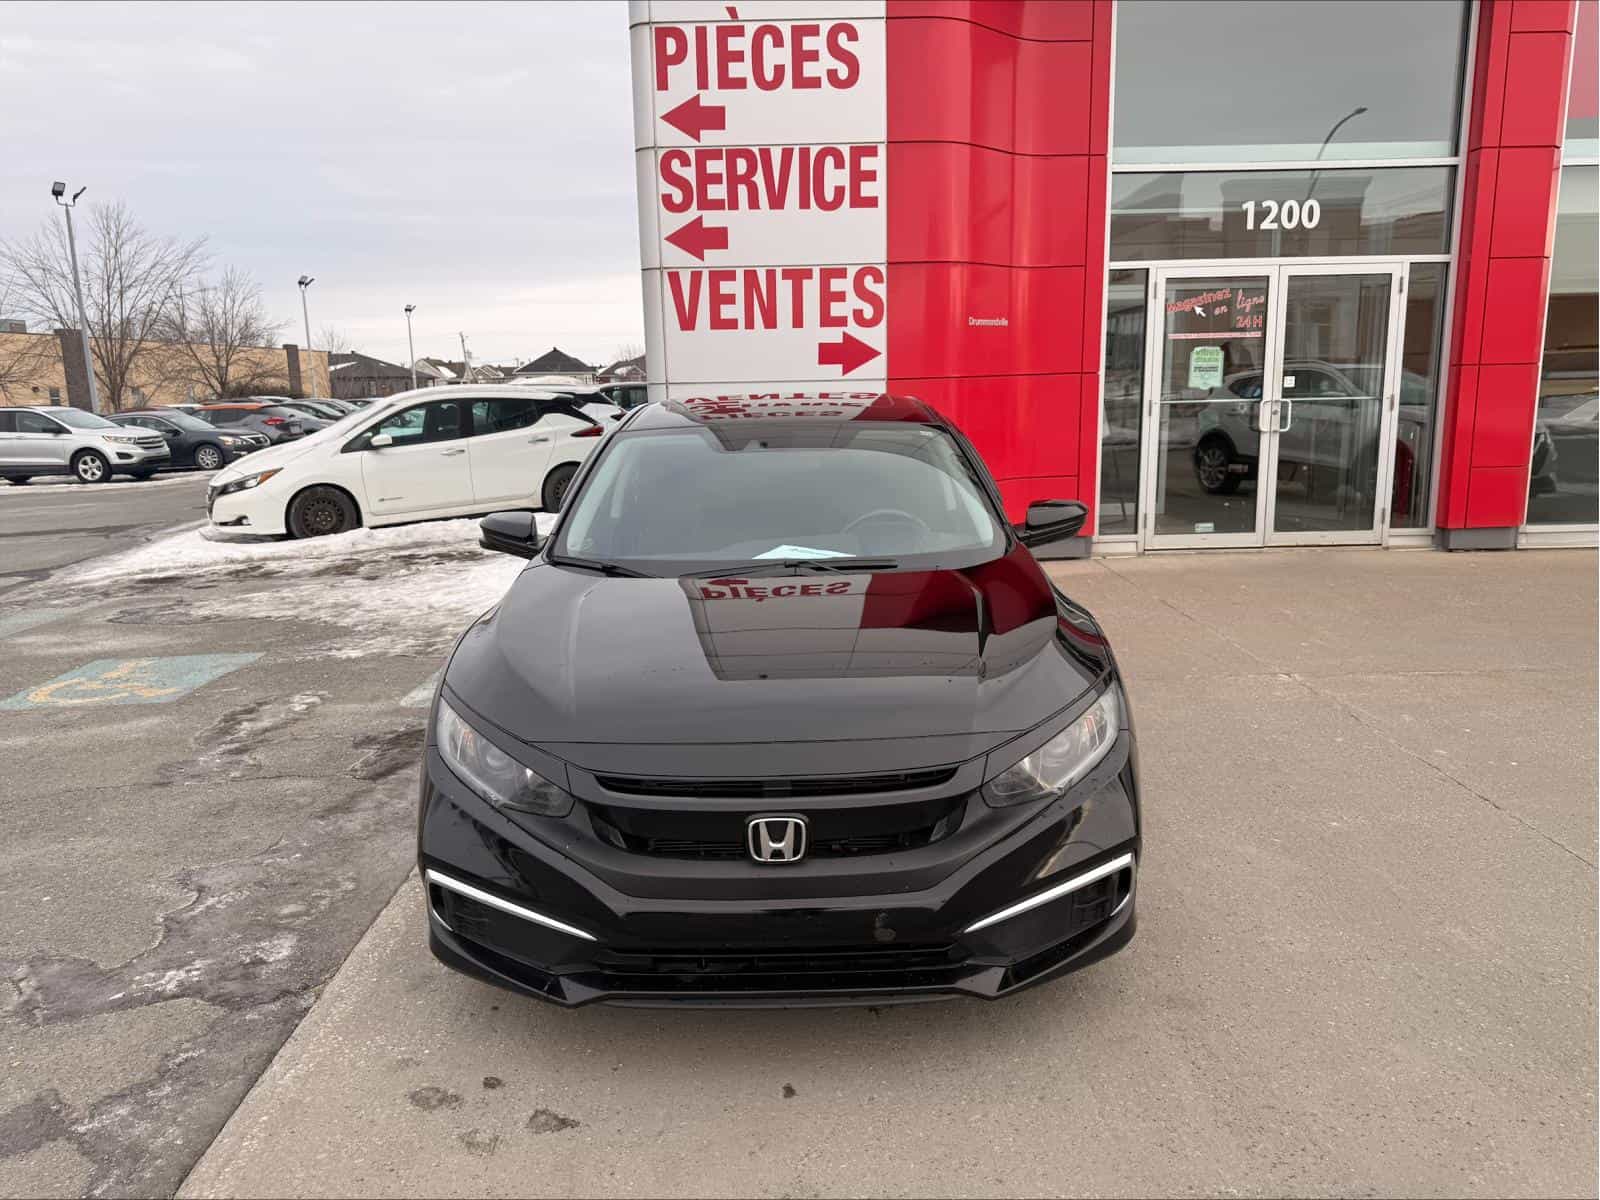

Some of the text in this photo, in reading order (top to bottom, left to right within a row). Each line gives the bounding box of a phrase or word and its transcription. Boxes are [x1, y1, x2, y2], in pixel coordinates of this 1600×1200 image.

[654, 6, 860, 91] PIÈCES
[660, 145, 878, 213] SERVICE
[1242, 199, 1320, 230] 1200
[667, 266, 885, 331] VENTES
